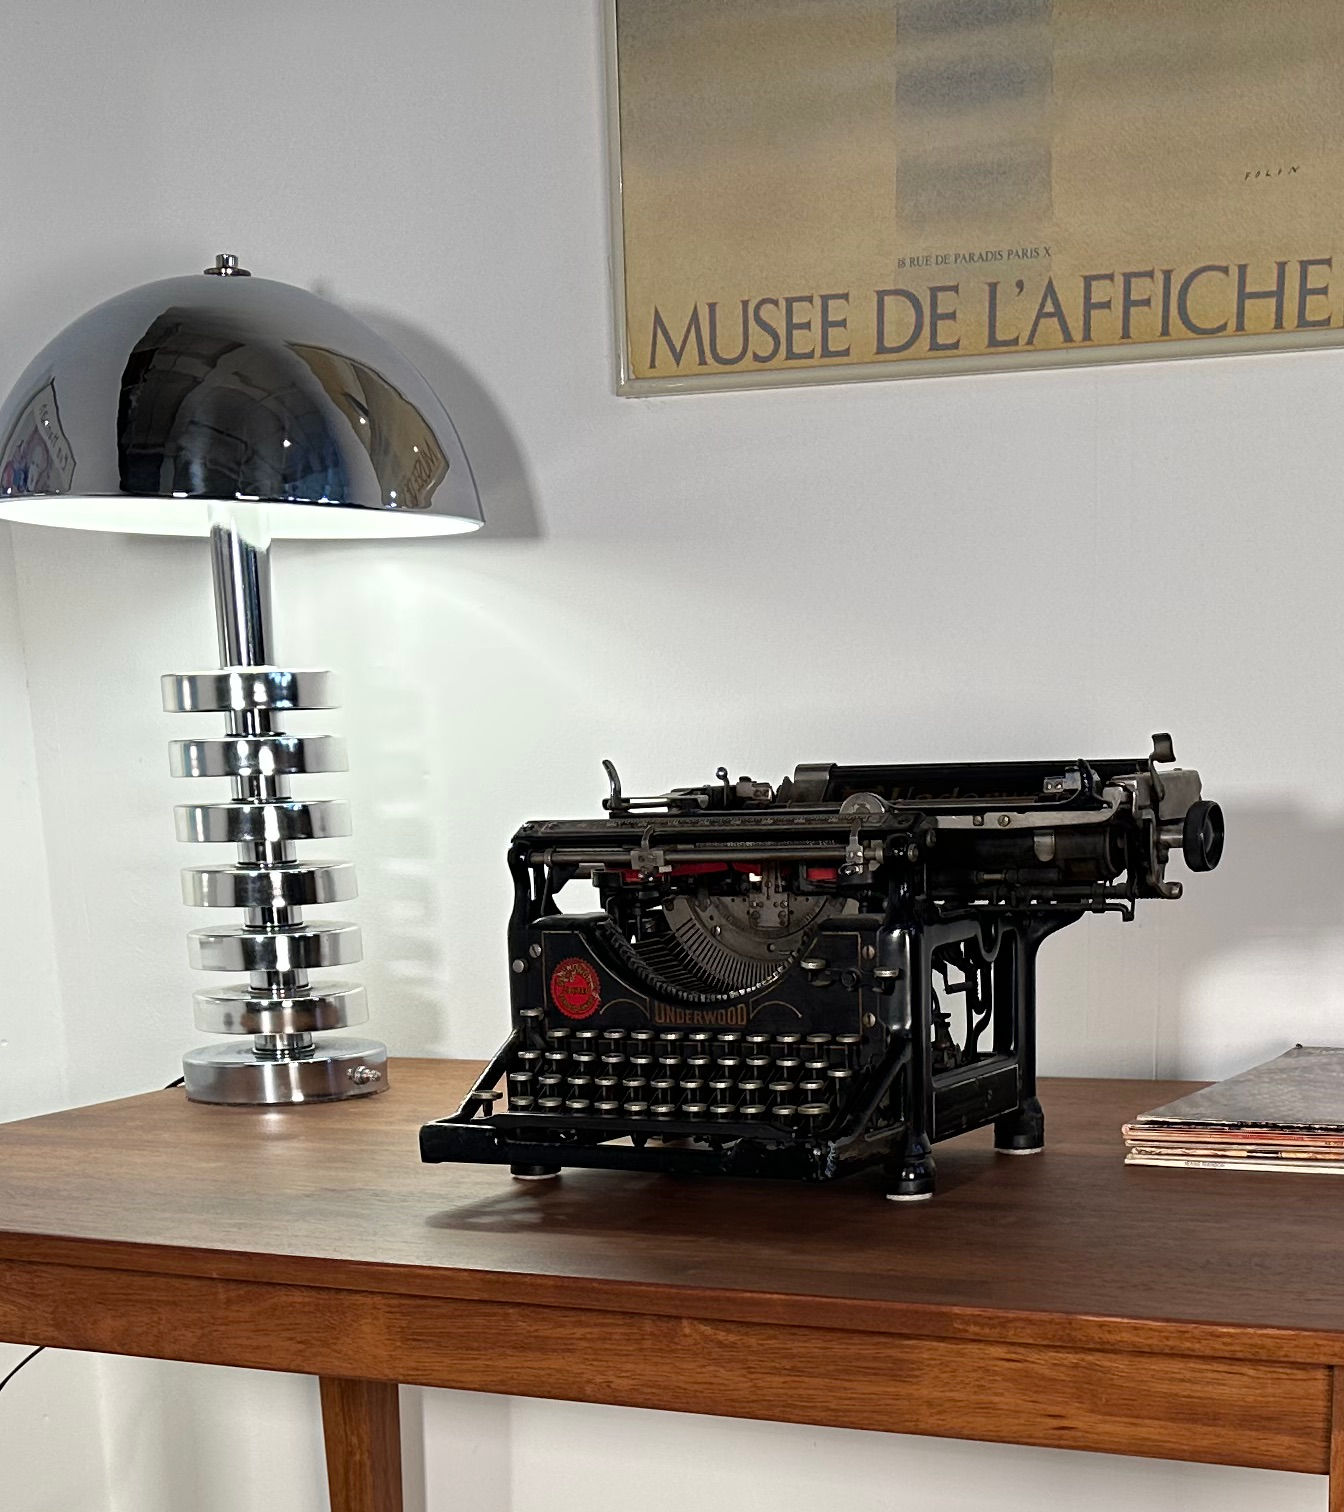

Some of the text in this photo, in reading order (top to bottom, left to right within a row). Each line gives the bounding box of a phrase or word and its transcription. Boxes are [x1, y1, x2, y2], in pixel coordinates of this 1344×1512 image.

[909, 254, 932, 268] RUE
[935, 253, 951, 266] DE
[954, 249, 1004, 265] PARADIS
[1006, 247, 1040, 261] PARIS
[1042, 246, 1052, 257] X
[647, 256, 1333, 370] MUSEE DE L'AFFICHE
[654, 1000, 747, 1025] UNDERWOOD
